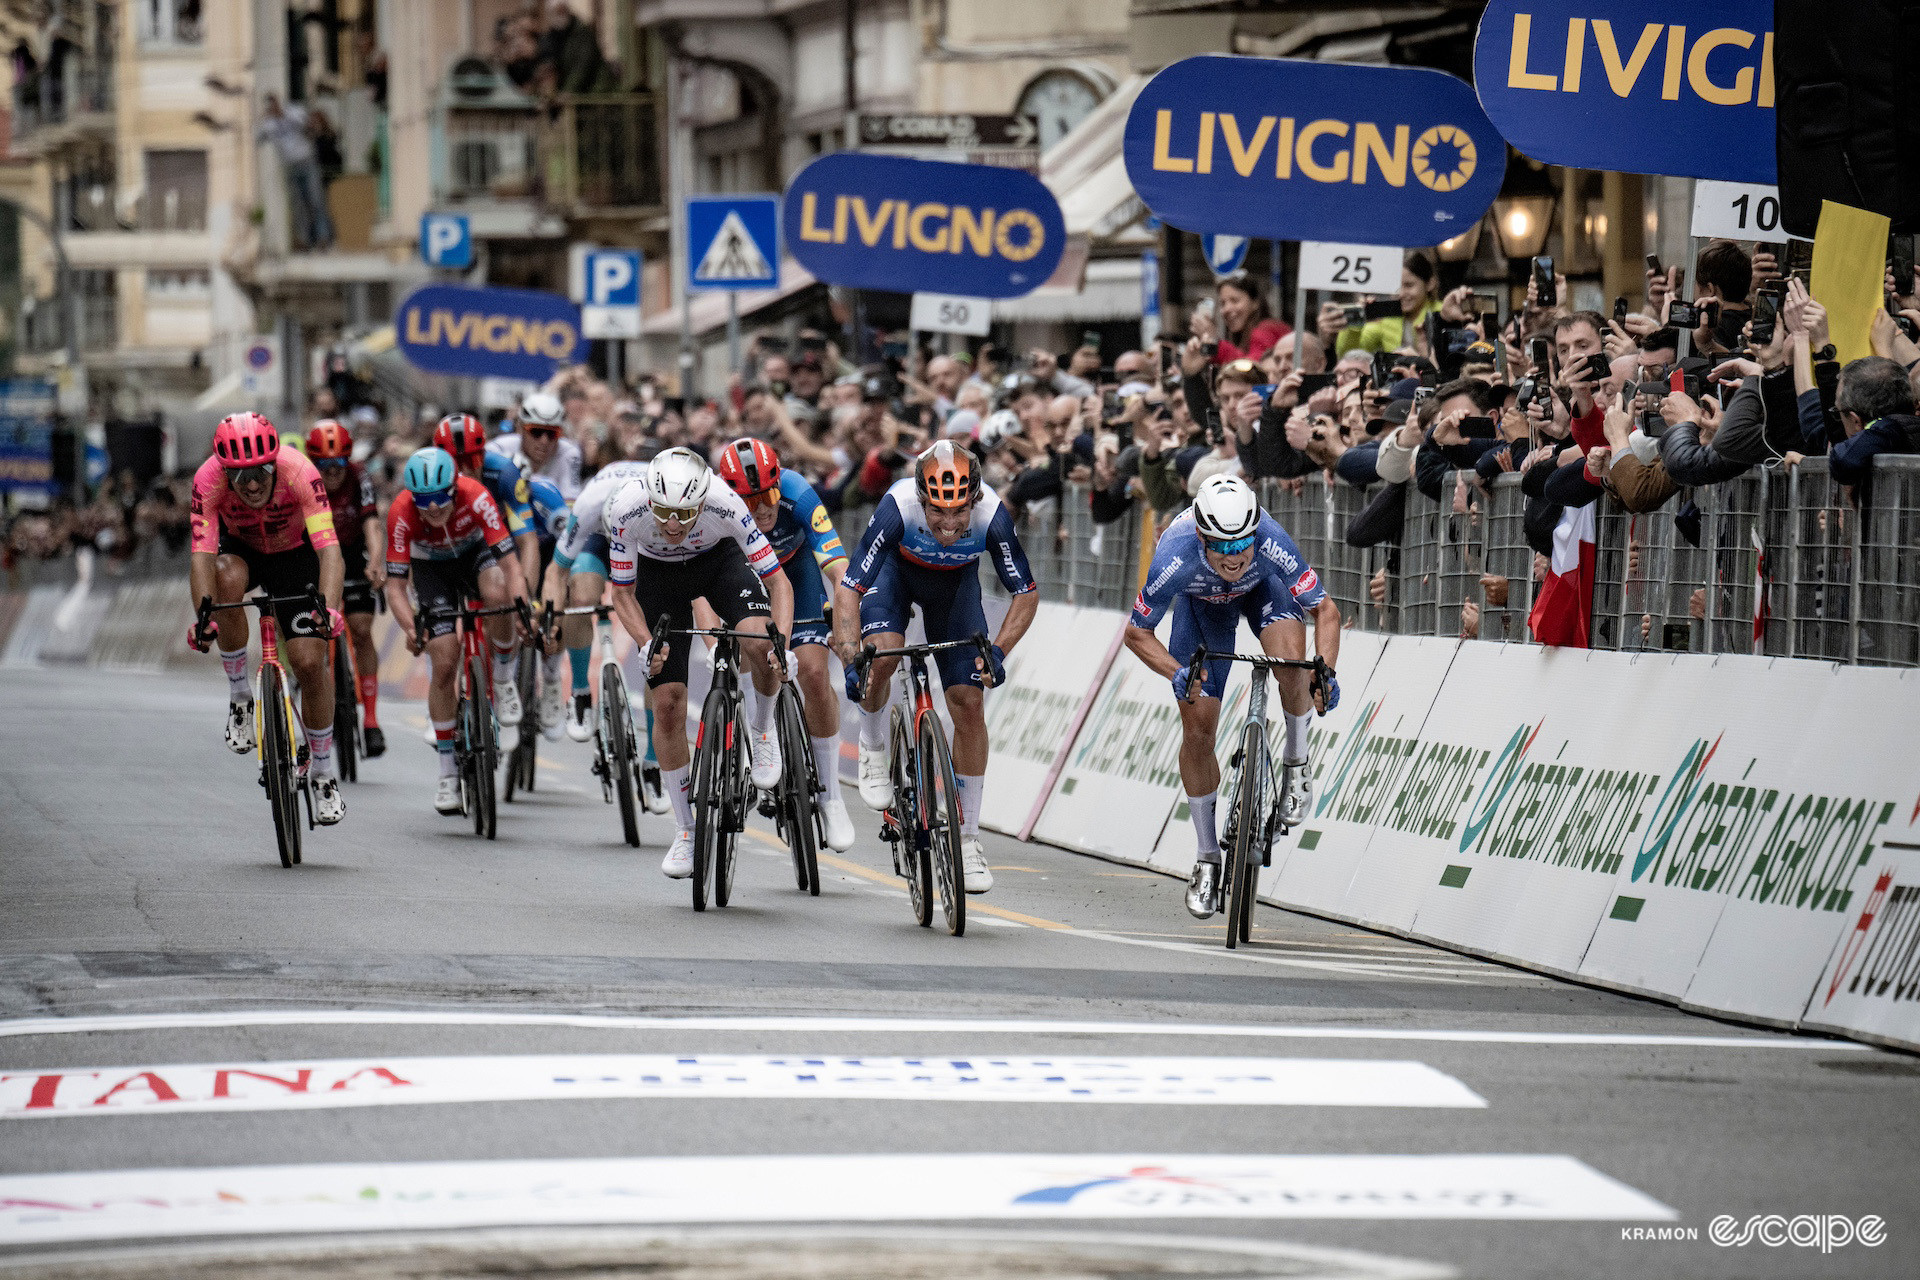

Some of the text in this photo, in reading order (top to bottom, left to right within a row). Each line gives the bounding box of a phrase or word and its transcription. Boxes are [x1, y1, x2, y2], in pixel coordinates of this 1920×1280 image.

[1152, 108, 1478, 193] LIVIGNO
[800, 193, 1046, 262] LIVIGNO
[1730, 193, 1780, 231] 10
[429, 220, 463, 263] P
[594, 256, 632, 304] P
[1331, 256, 1372, 284] 25
[406, 305, 577, 360] LIVIGNO
[939, 302, 971, 326] 50
[472, 491, 501, 531] lotto
[618, 504, 650, 525] presight
[703, 503, 736, 519] presight
[860, 528, 886, 574] GIANT
[998, 540, 1022, 580] GIANT
[1260, 537, 1299, 573] Alpecin
[1145, 555, 1184, 597] deceuninck
[1335, 714, 1419, 826] CRÉDIT
[1382, 741, 1492, 841] AGRICOLE
[1488, 739, 1661, 875] CRÉDIT AGRICOLE
[1665, 757, 1897, 914] CRÉDIT AGRICOLE
